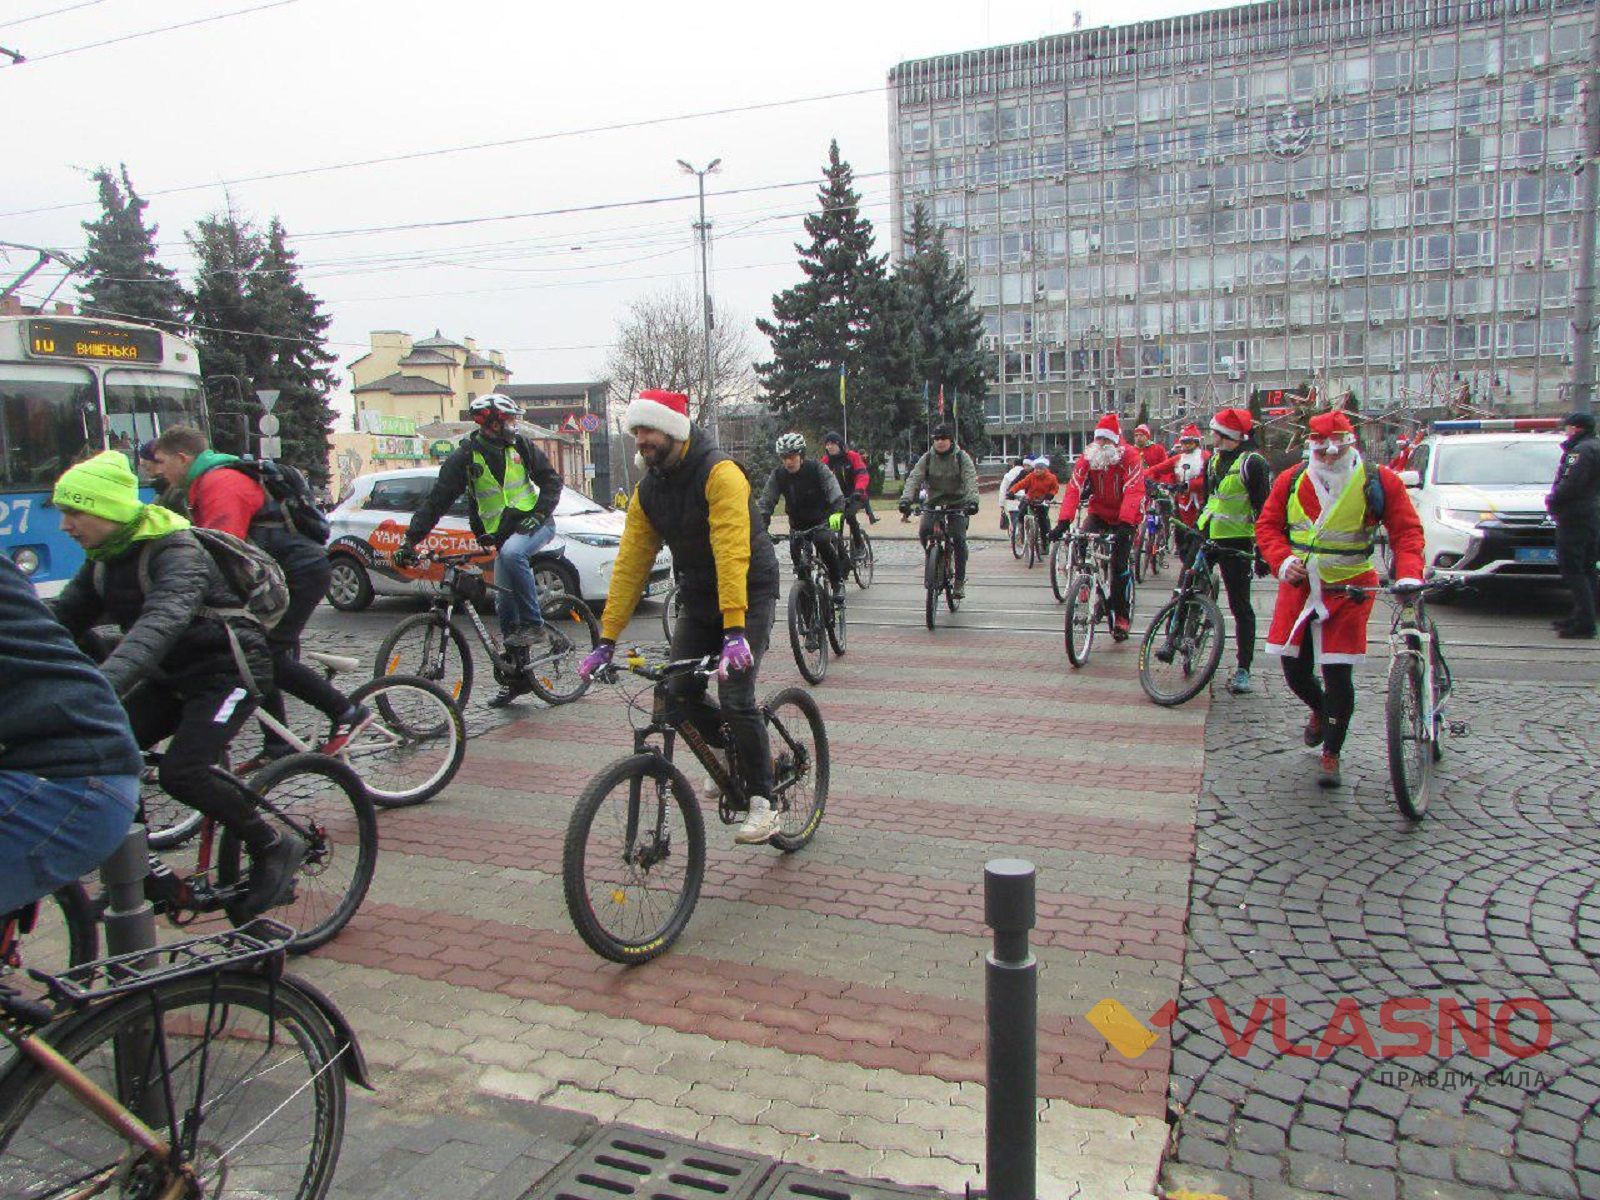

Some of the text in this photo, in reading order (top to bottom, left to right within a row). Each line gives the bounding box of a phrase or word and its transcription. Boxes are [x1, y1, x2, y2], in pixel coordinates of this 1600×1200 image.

[76, 342, 137, 358] ВИШЕНЬКА
[0, 500, 32, 535] 27
[415, 535, 496, 552] ДОСТАВ
